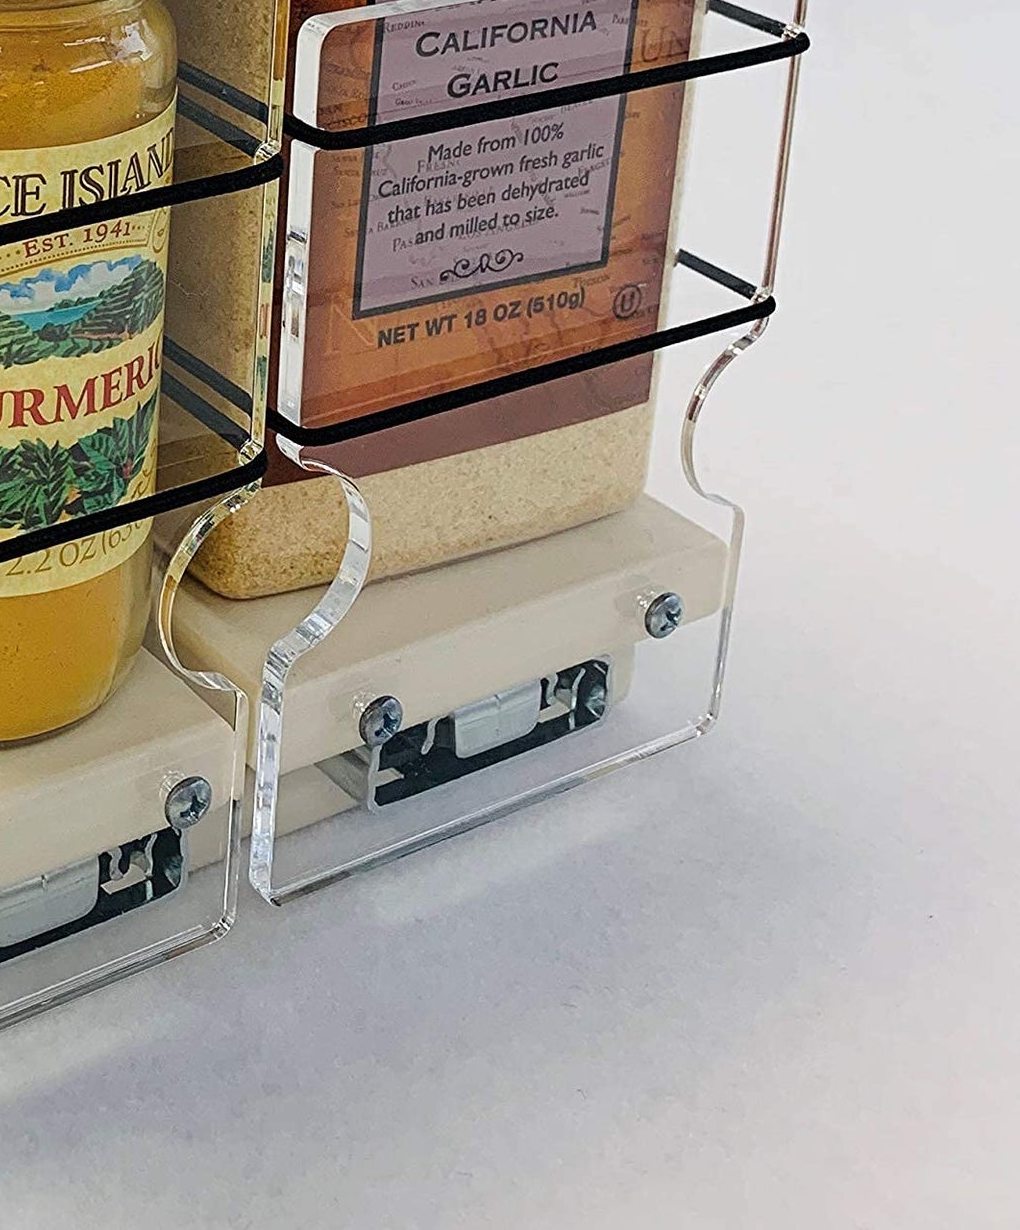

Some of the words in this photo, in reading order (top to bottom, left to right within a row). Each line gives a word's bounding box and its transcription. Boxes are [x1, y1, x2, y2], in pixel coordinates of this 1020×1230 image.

[415, 10, 598, 58] CALIFORNIA
[446, 62, 560, 99] GARLIC
[428, 140, 473, 163] Made
[477, 135, 516, 155] from
[523, 122, 565, 147] 100%
[378, 161, 515, 199] California-grown
[519, 150, 559, 172] fresh
[561, 141, 605, 169] garlic
[387, 203, 421, 225] that
[425, 197, 452, 217] has
[457, 190, 496, 211] been
[501, 170, 589, 203] dehydrated
[24, 232, 73, 259] EST.
[82, 219, 132, 244] 1941
[415, 221, 446, 245] and
[449, 209, 498, 239] milled
[503, 210, 521, 227] to
[524, 203, 559, 224] size.
[378, 323, 419, 349] NET
[425, 314, 458, 337] WT
[464, 308, 487, 329] 18
[493, 300, 521, 322] OZ
[525, 287, 586, 319] (510g)
[59, 536, 98, 567] OZ
